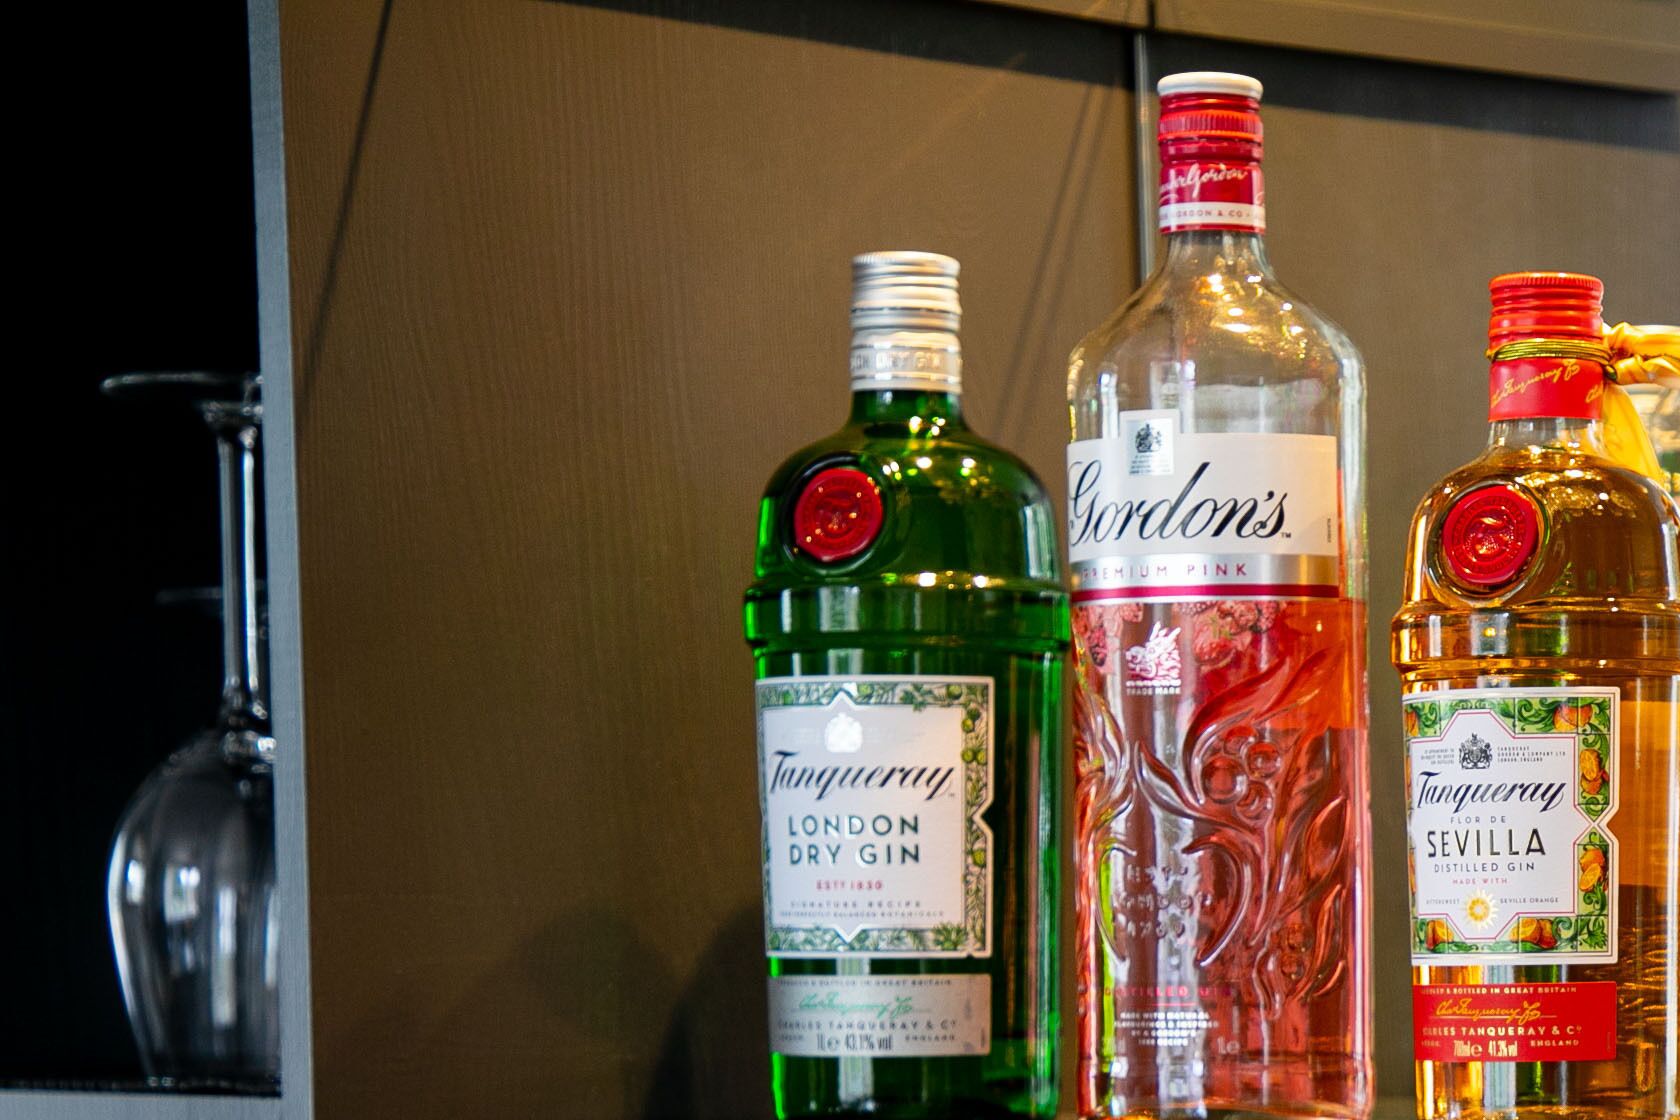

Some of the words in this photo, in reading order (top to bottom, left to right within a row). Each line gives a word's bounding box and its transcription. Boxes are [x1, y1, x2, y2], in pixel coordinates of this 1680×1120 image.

[1069, 459, 1288, 547] Gordon's
[1083, 565, 1168, 580] PREMIUM
[1187, 563, 1247, 577] PINK
[769, 750, 954, 801] Tanqueray
[1416, 771, 1567, 813] Tanqueray
[787, 815, 919, 836] LONDON
[1450, 816, 1480, 824] FLOR
[1491, 815, 1506, 823] DE
[1427, 828, 1546, 858] SEVILLA
[789, 844, 841, 865] DRY
[859, 844, 920, 864] GIN
[1434, 862, 1499, 873] DISTILLED
[1508, 862, 1535, 871] GIN
[1483, 877, 1508, 885] WITH
[1503, 986, 1534, 994] GREAT
[1462, 1026, 1546, 1036] TANQUERAY
[1551, 1026, 1560, 1035] &
